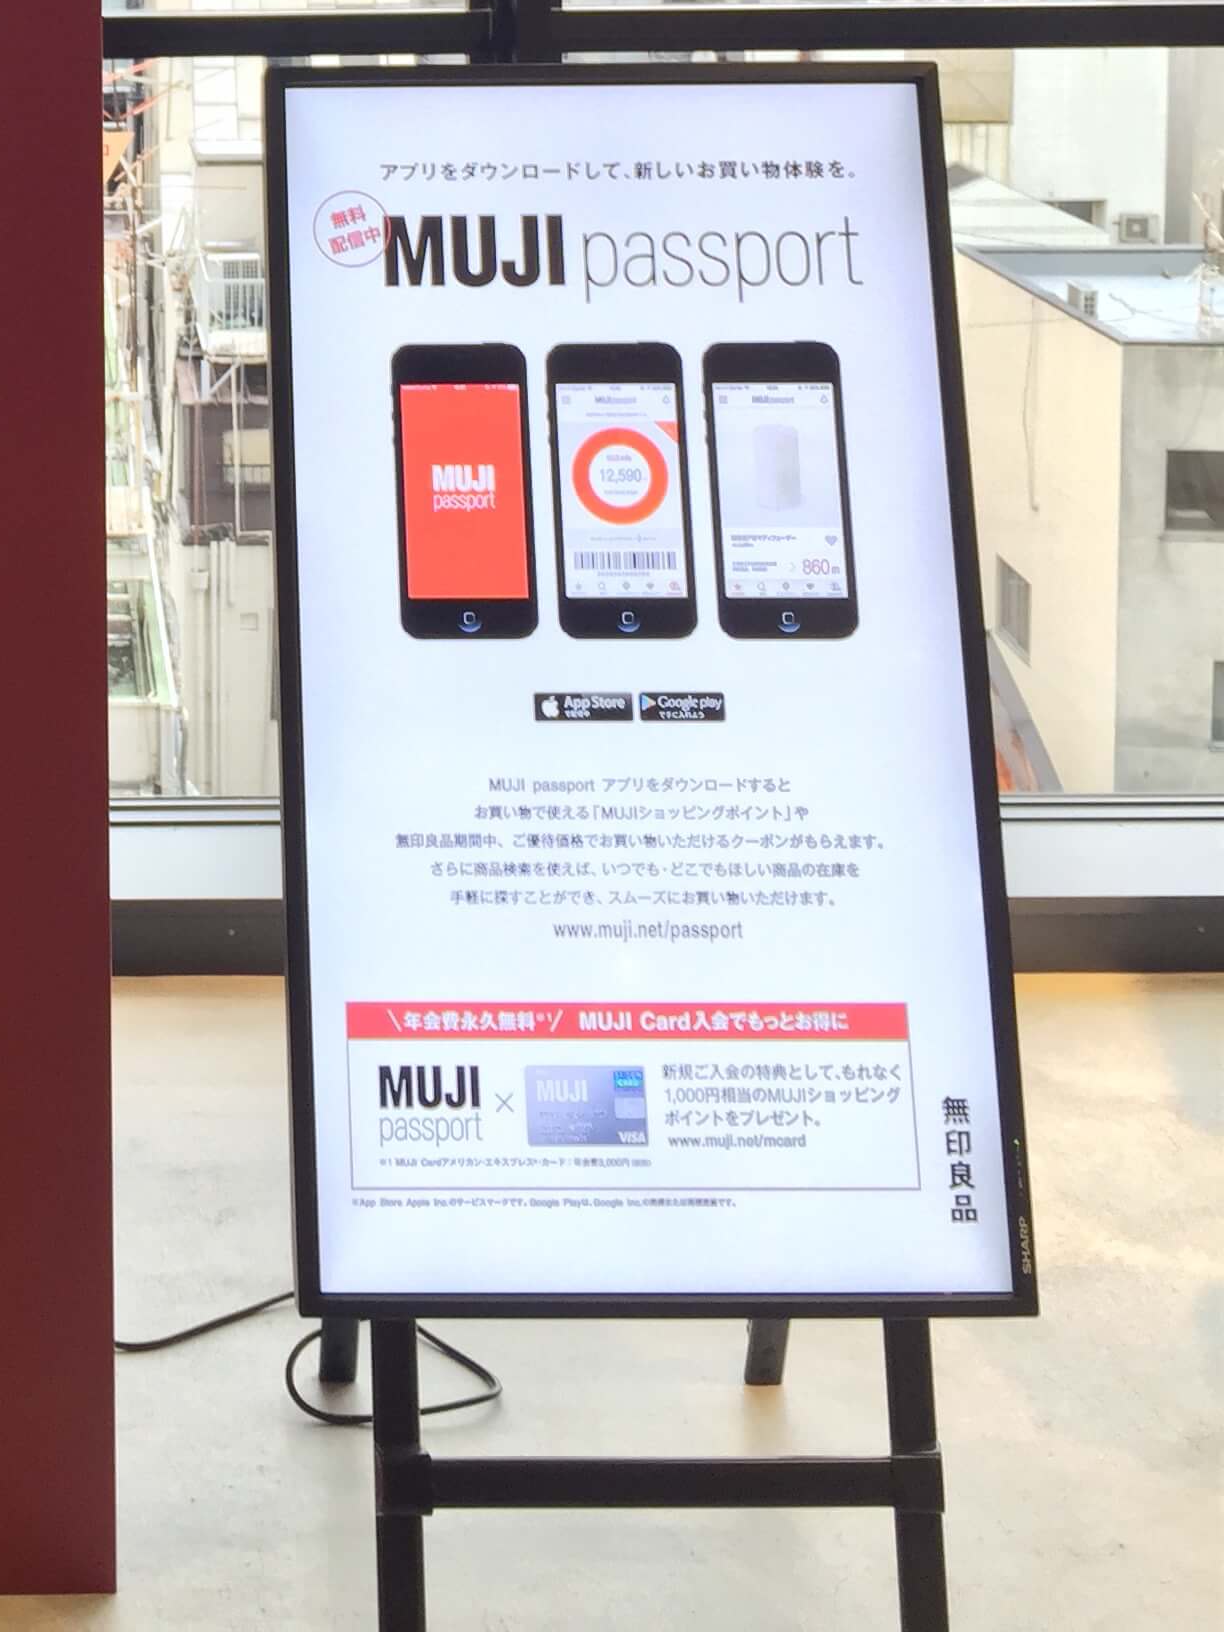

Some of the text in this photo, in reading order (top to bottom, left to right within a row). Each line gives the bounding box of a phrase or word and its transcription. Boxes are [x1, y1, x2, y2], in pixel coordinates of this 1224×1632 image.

[379, 160, 857, 182] アプリをダウンロードして、新しいお買い物体験を。
[328, 203, 368, 230] 無料
[327, 226, 382, 256] 配信中
[383, 214, 864, 304] MUJI passport
[431, 464, 495, 494] MUJI
[432, 491, 496, 513] passport
[564, 695, 626, 712] App Store
[657, 695, 698, 712] Google
[488, 776, 792, 795] MUJI passport アプリをダウンロードすると
[552, 919, 744, 945] www.muji.net/passport
[578, 1010, 634, 1032] MUJI
[378, 1064, 482, 1109] MUJI
[535, 1078, 589, 1103] MUJI
[665, 1087, 901, 1105] 1,000円相当のMUJIショッピング
[664, 1110, 822, 1127] ポイントをプレゼント。
[379, 1115, 483, 1148] passport
[617, 1130, 647, 1145] VISA
[667, 1134, 808, 1150] www.muji.net/mcard
[941, 1095, 979, 1224] 無印良品
[1018, 1215, 1032, 1275] SHARP
